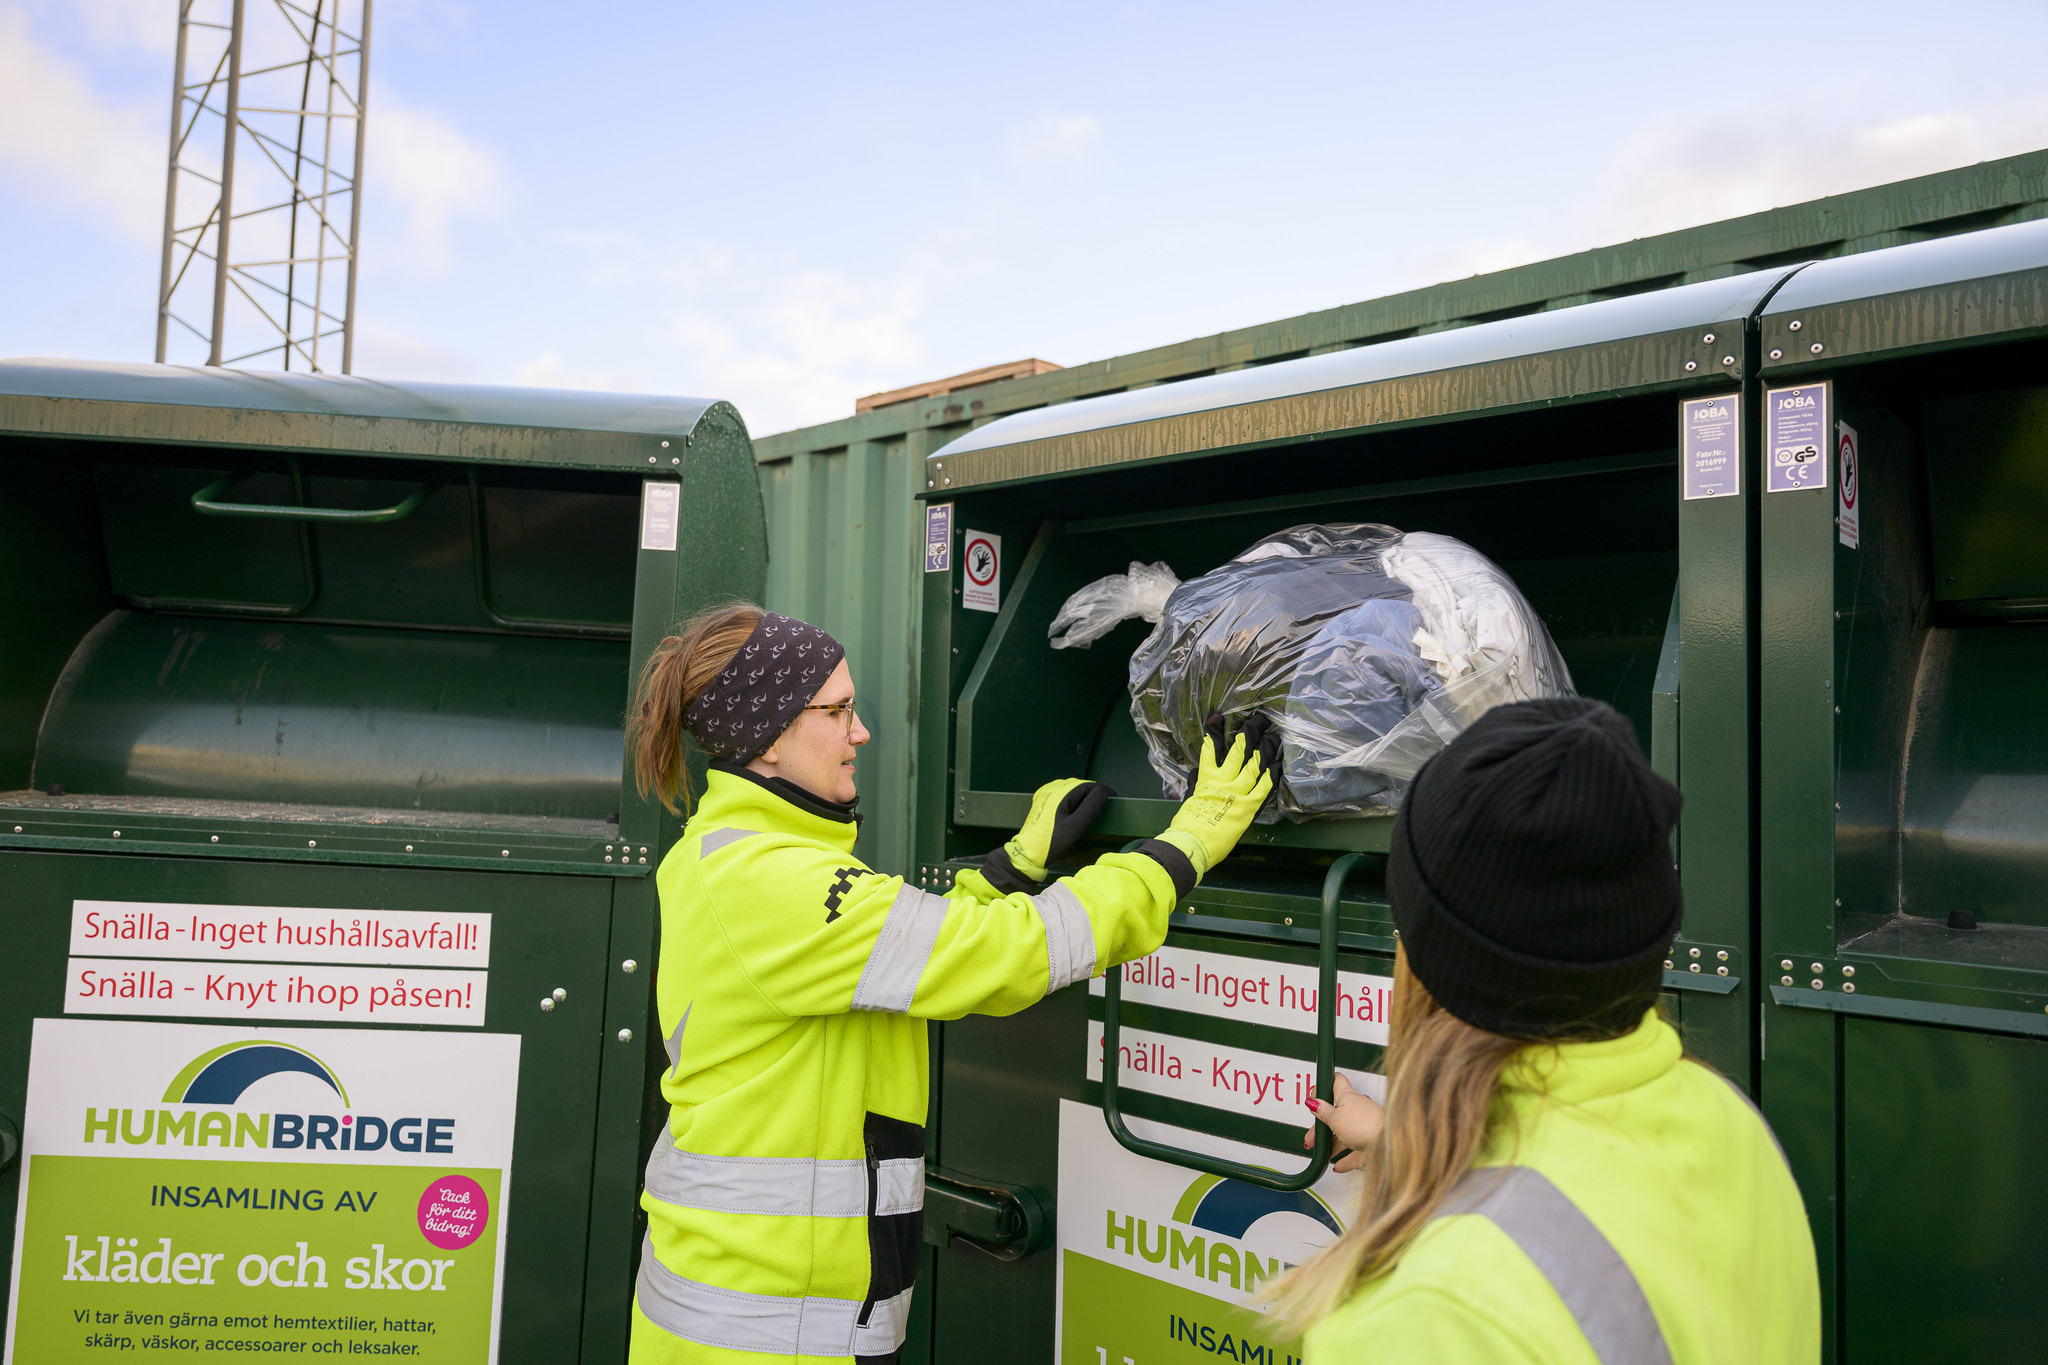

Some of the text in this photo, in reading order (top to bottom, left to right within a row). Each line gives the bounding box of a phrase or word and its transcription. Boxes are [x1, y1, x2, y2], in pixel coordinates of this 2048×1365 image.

[1693, 407, 1728, 420] JOBA
[1778, 396, 1816, 410] JOBA
[1695, 457, 1727, 467] 2016999
[1795, 446, 1817, 462] GS
[1785, 465, 1807, 480] CE
[1214, 794, 1236, 822] GUIDE
[85, 912, 169, 940] Snälla
[191, 916, 267, 949] Inget
[276, 917, 478, 950] hushållsavfall!
[79, 970, 173, 999] Snälla
[205, 974, 277, 1009] Knyt
[287, 976, 359, 1011] ihop
[369, 979, 472, 1012] påsen!
[1101, 955, 1175, 989] nälla
[1195, 964, 1270, 1007] Inget
[1212, 1056, 1284, 1105] Knyt
[151, 1185, 378, 1213] INSAMLING AV
[440, 1188, 471, 1204] Tack
[426, 1203, 477, 1220] för ditt
[425, 1218, 474, 1238] bidrag!
[63, 1235, 455, 1291] kläder och skor
[74, 1309, 436, 1334] Vi tar även gärna emot hemtextilier, hattar,
[85, 1333, 421, 1355] skärp, väskor, accessoarer och leksaker.
